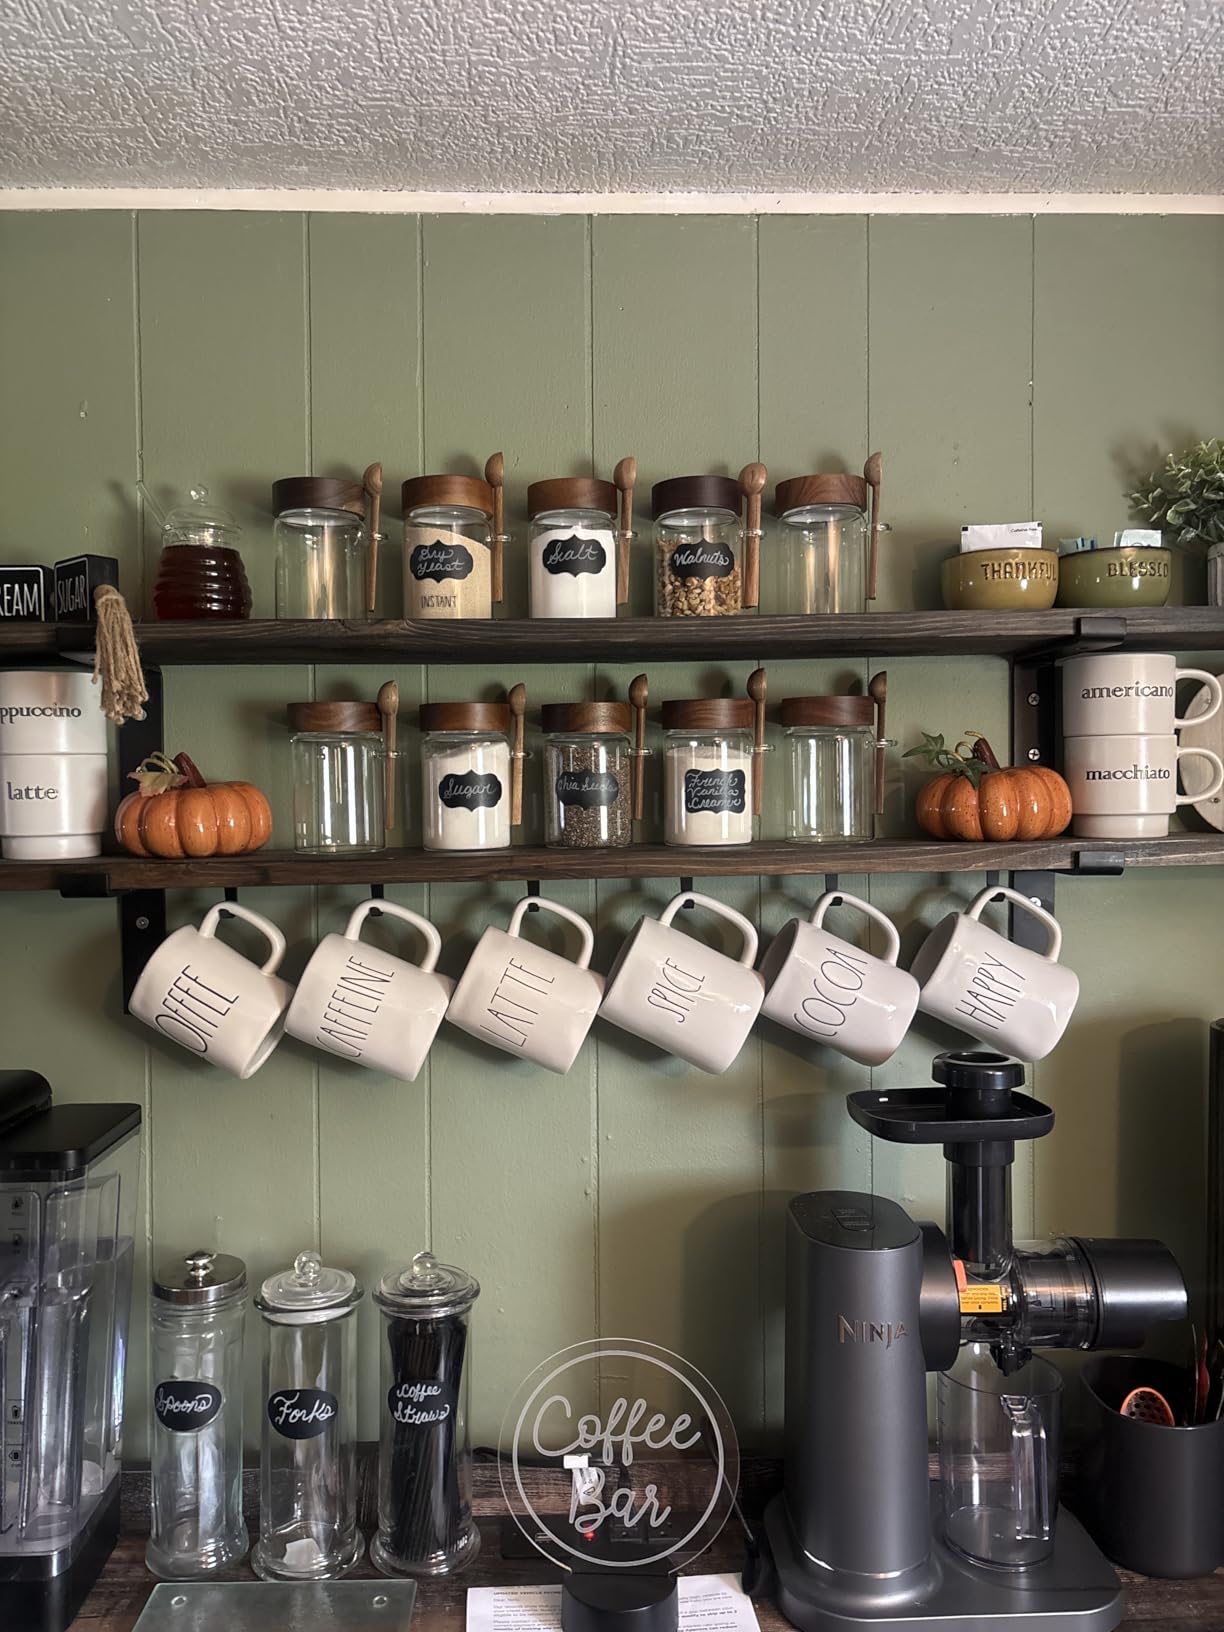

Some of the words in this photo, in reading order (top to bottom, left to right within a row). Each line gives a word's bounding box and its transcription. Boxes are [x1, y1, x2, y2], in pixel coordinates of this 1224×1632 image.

[547, 542, 599, 565] Salt
[673, 547, 730, 567] Walnuts
[980, 562, 1057, 581] THANKFUL
[1107, 561, 1169, 578] BLESSED
[57, 574, 87, 614] SUGAR
[420, 594, 457, 608] INSTANT
[1081, 681, 1174, 699] americano
[557, 775, 580, 791] Chia
[686, 771, 738, 788] French
[1086, 764, 1170, 780] macchiato
[7, 781, 58, 800] latte
[443, 780, 498, 801] Sugar
[687, 786, 739, 797] Vanilla
[647, 957, 706, 1023] SPICE
[794, 947, 868, 1037] COCOA
[955, 952, 1026, 1030] HAPPY
[316, 955, 395, 1058] CAFFEINE
[480, 957, 556, 1047] LATTE
[837, 1313, 909, 1349] NINJA
[156, 1387, 213, 1417] Spoons
[397, 1383, 442, 1404] Coffee
[273, 1392, 336, 1425] Forks
[393, 1402, 451, 1425] Straws
[532, 1395, 702, 1466] Coffee
[567, 1467, 672, 1534] Bar
